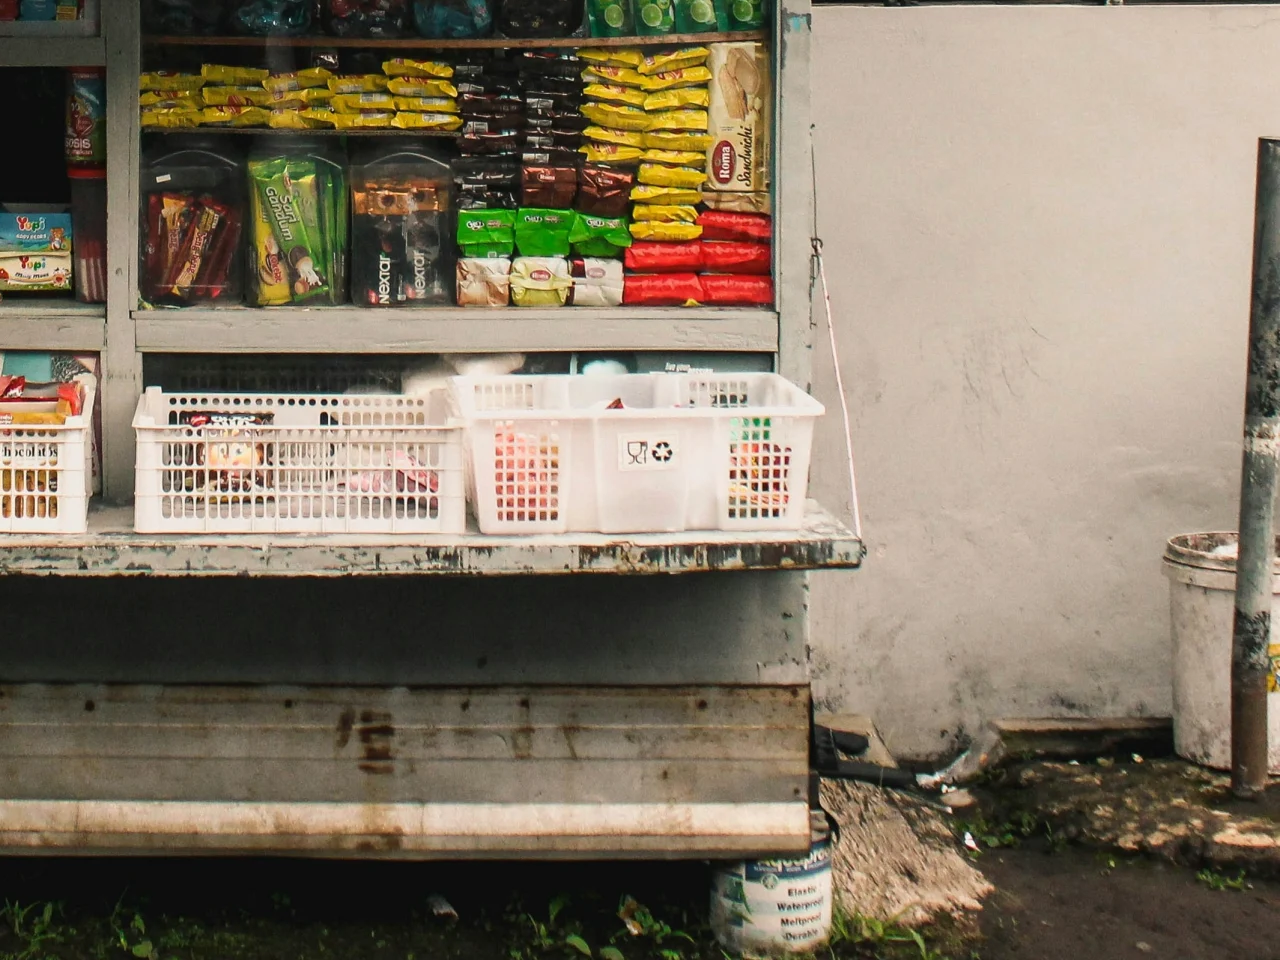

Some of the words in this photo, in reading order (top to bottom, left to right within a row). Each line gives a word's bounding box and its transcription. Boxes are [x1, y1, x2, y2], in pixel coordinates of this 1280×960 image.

[720, 146, 731, 179] Roma
[266, 186, 293, 241] Gandum
[280, 195, 300, 223] Sari
[16, 215, 47, 232] Yupi
[19, 256, 46, 271] Yupi
[788, 886, 816, 897] Elastic
[777, 896, 824, 912] Waterproof
